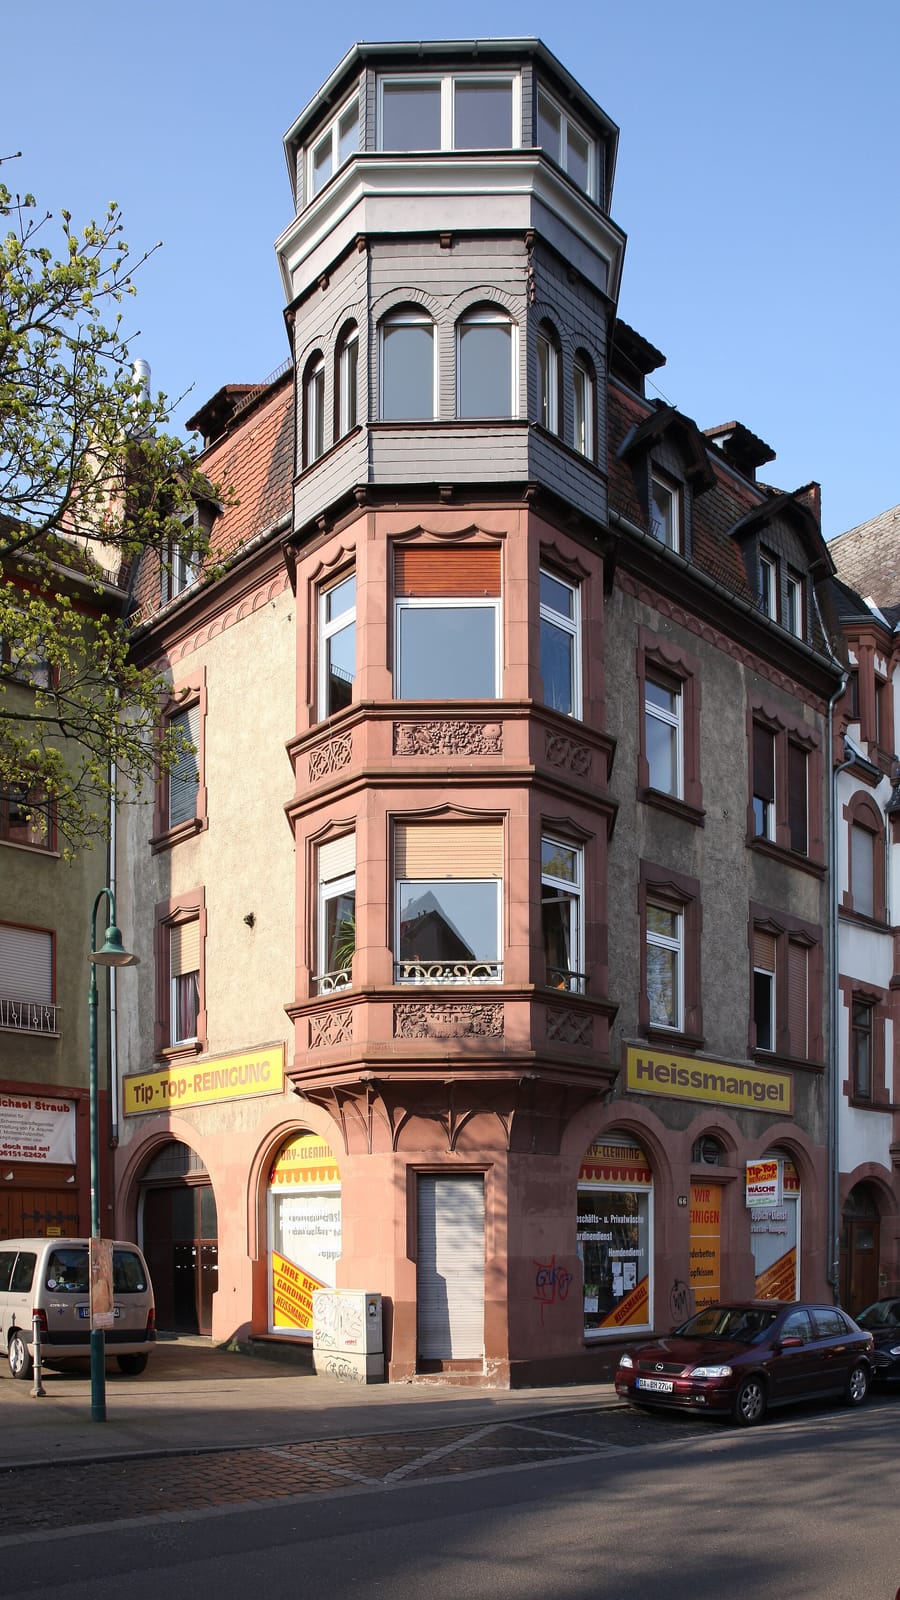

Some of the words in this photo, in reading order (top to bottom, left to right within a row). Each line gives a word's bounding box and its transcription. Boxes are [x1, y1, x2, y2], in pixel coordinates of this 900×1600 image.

[636, 1059, 784, 1102] Heissmangel
[34, 1101, 70, 1112] Straub
[694, 1188, 710, 1203] WIR
[747, 1185, 776, 1193] WÄSCHE
[678, 1197, 687, 1205] 66
[576, 1213, 603, 1224] eschäfts-
[689, 1209, 720, 1224] EINIGEN
[280, 1262, 300, 1283] IHRE
[276, 1295, 310, 1328] HEISSMANGEL
